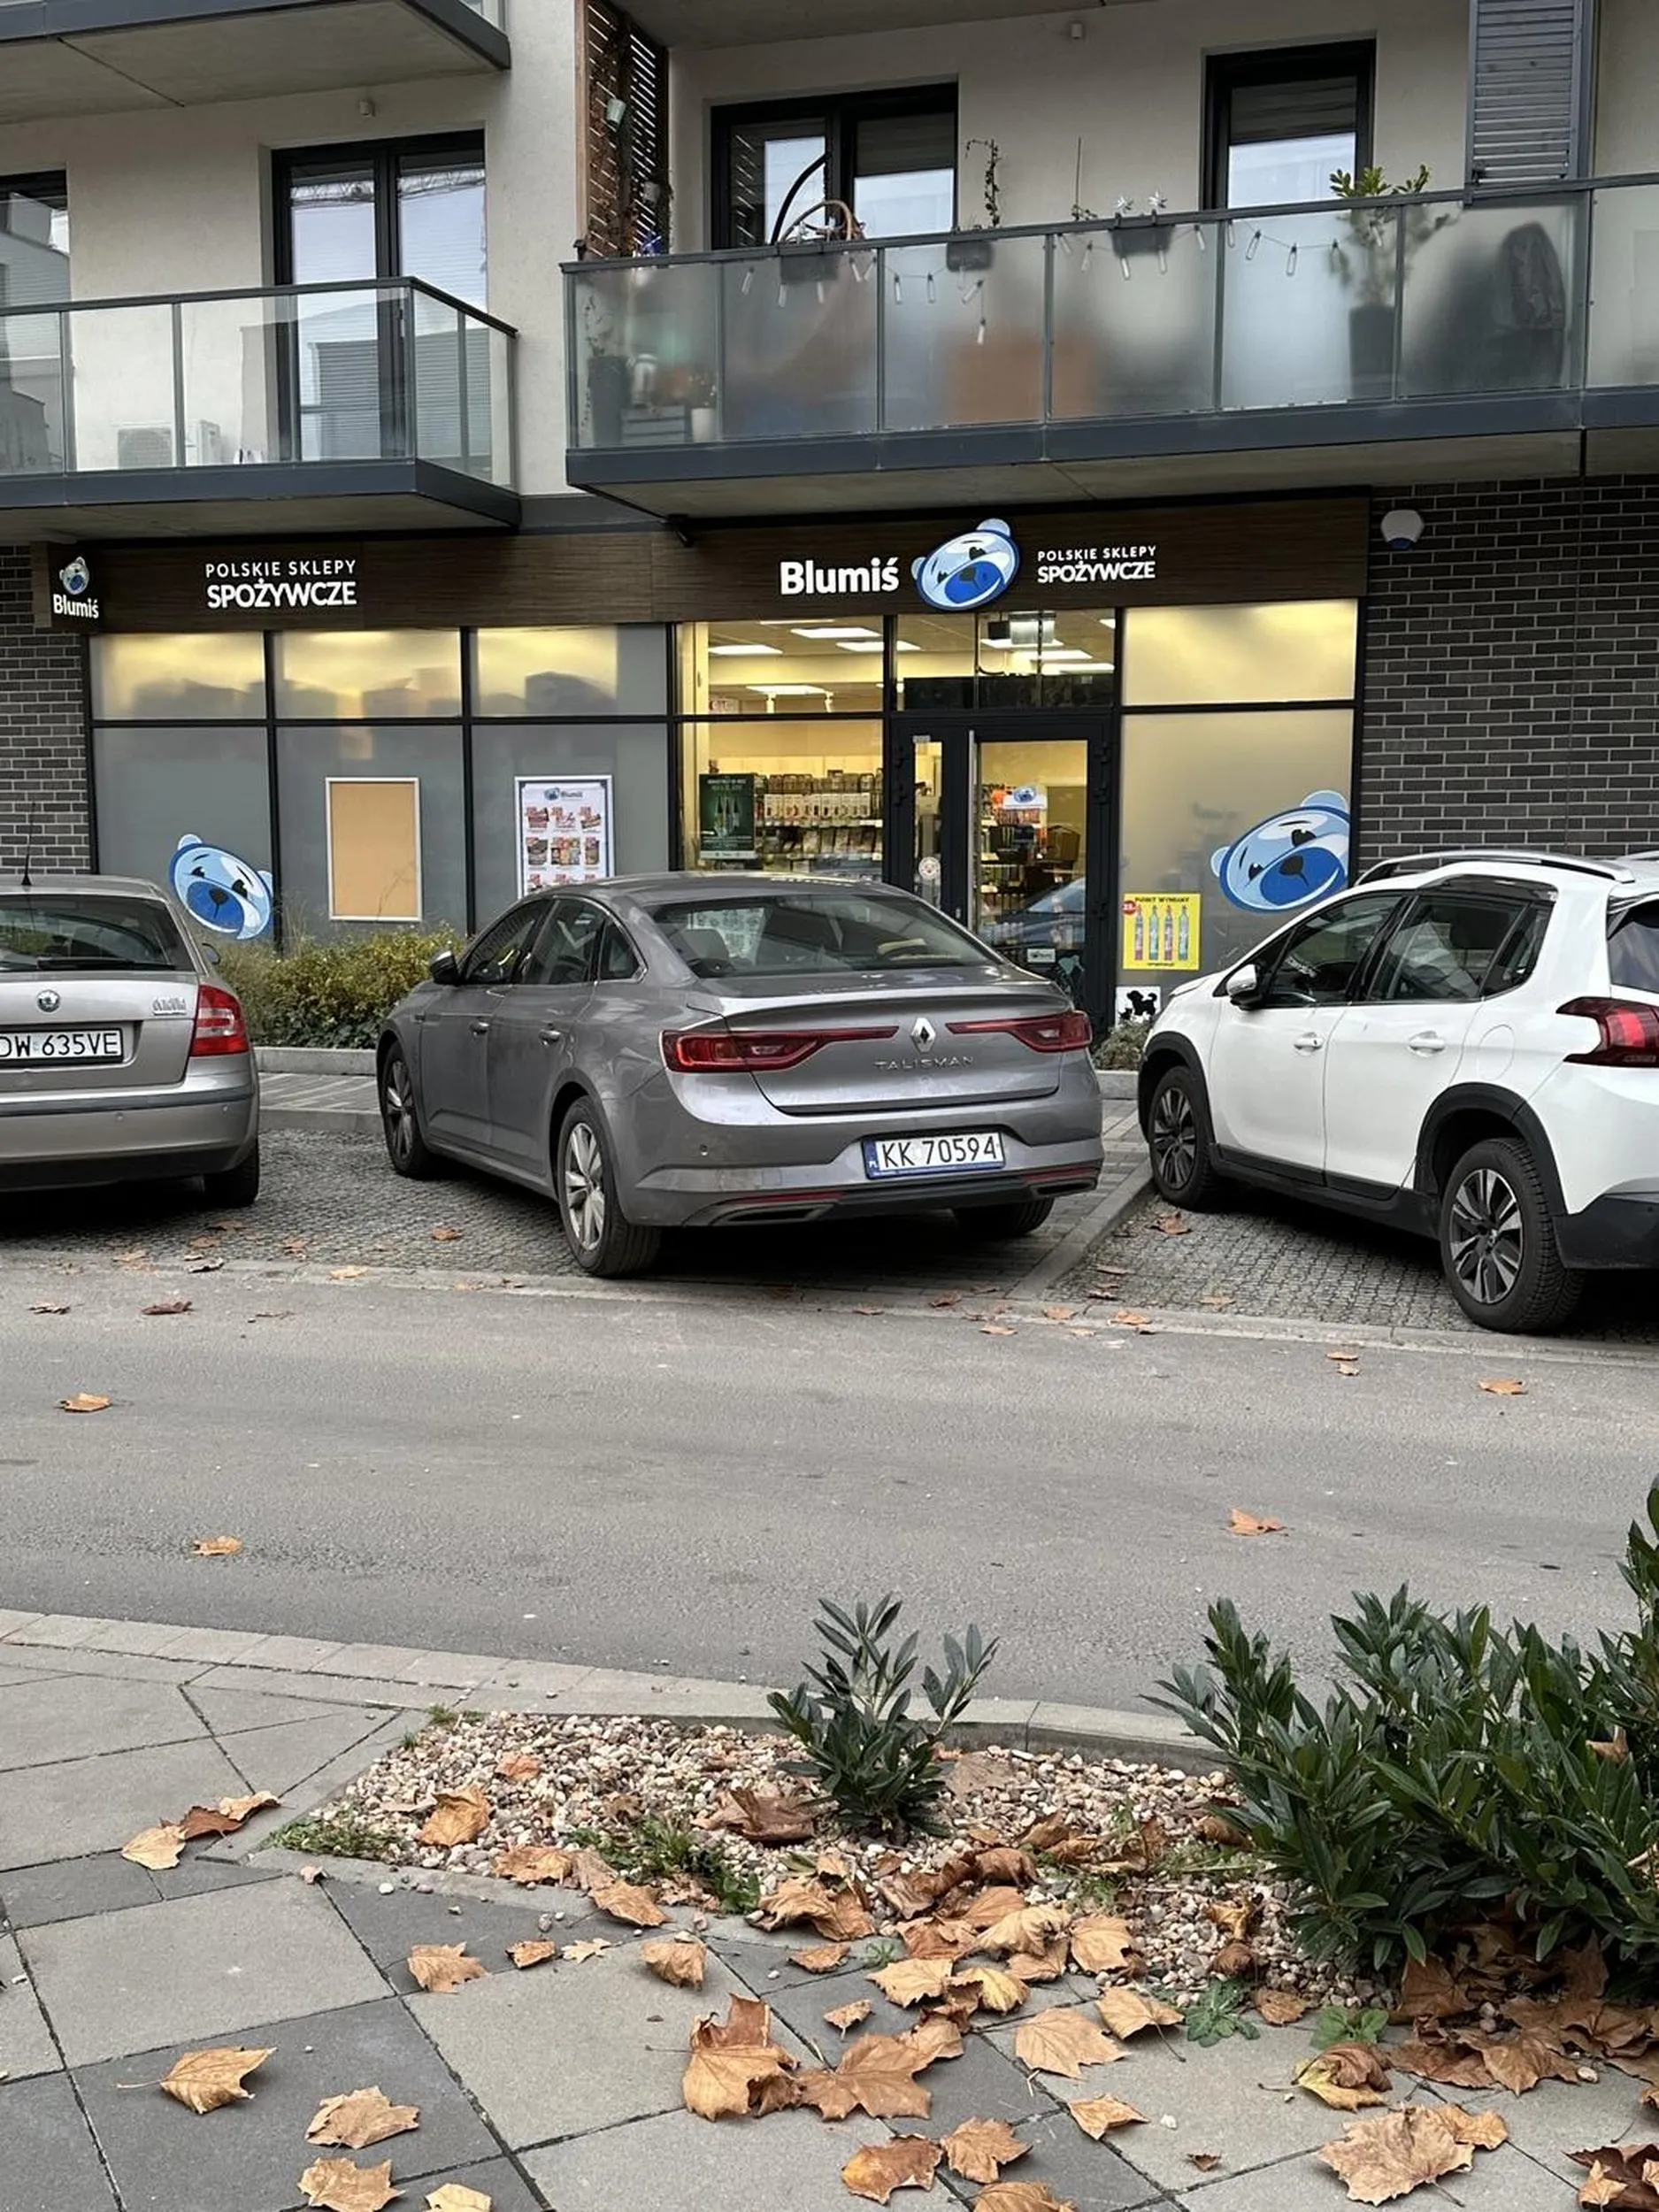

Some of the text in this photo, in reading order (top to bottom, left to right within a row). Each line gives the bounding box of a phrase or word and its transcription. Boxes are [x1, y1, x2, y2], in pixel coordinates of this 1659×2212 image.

[1037, 545, 1156, 561] POLSKIE SKLEPY
[205, 559, 356, 578] POLSKIE SKLEPY
[780, 557, 900, 595] Blumiś
[1037, 560, 1156, 583] SPOŻYWCZE
[207, 577, 357, 608] SPOŻYWCZE
[53, 594, 99, 618] Blumiś
[42, 1033, 118, 1056] 635VE
[873, 1056, 973, 1071] TALISMAN
[882, 1135, 996, 1168] KK 70594
